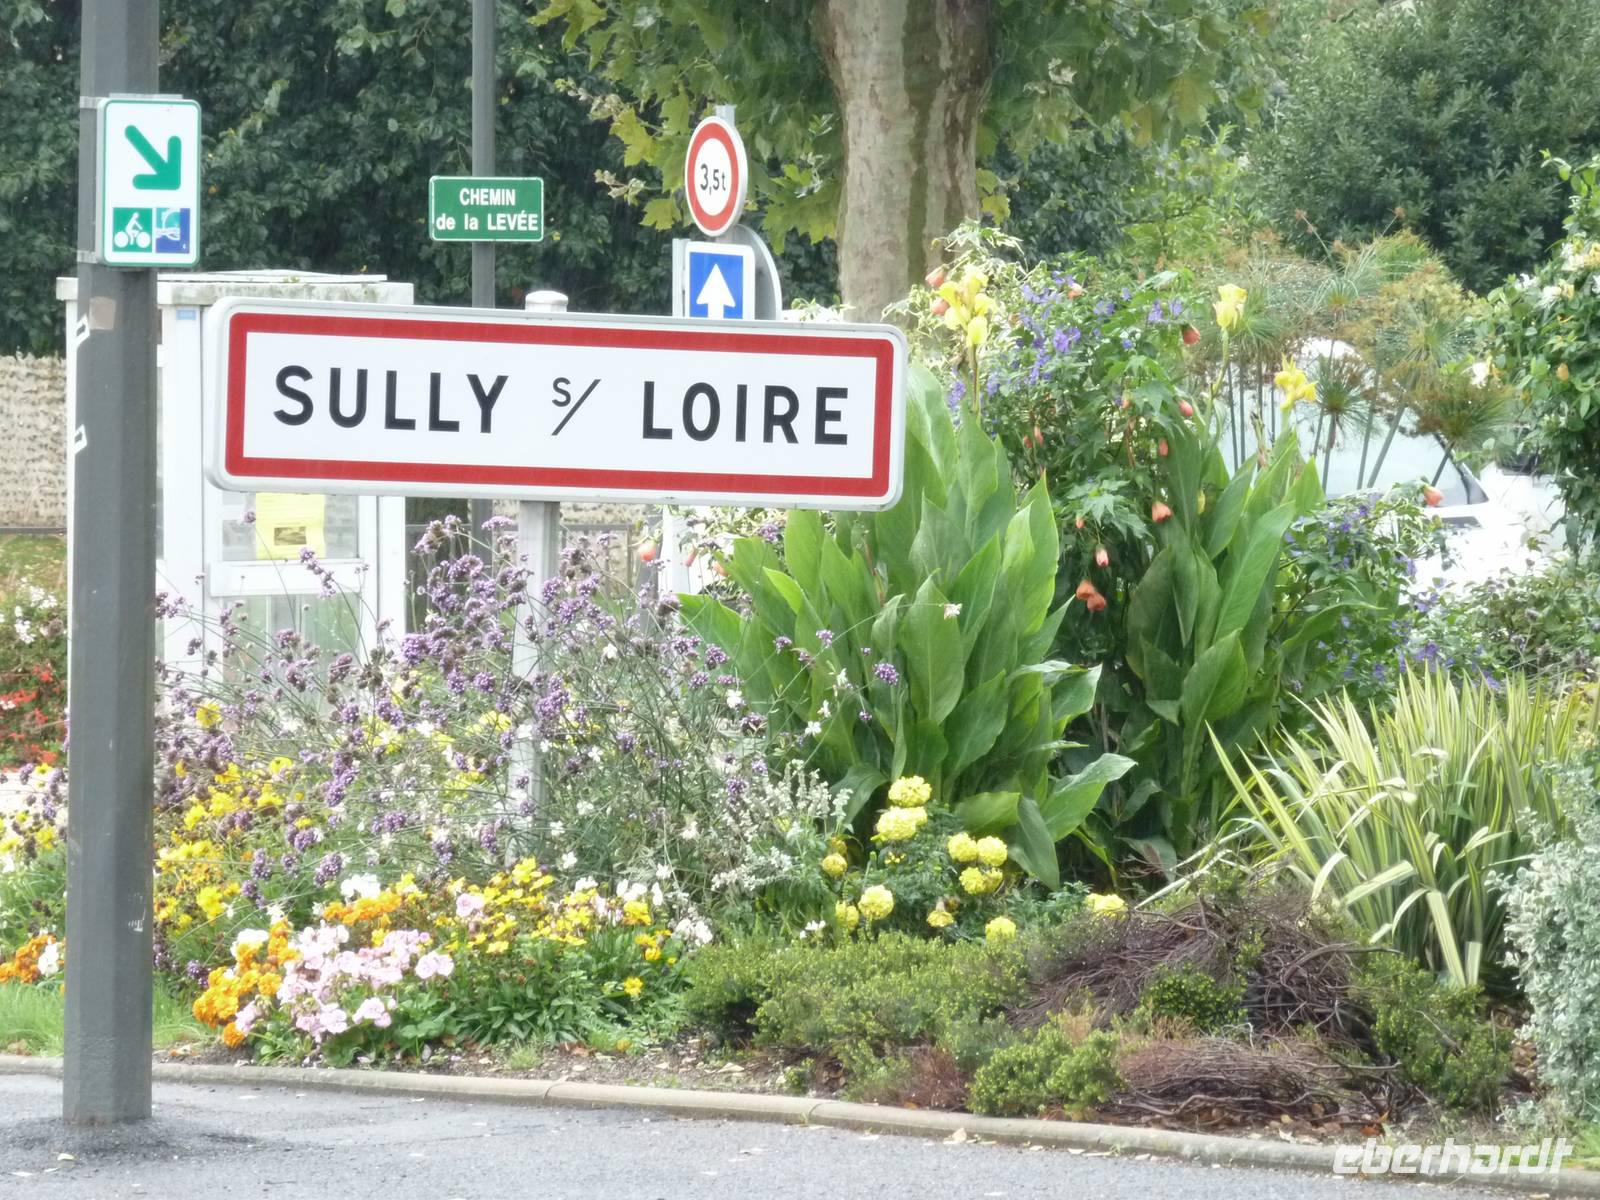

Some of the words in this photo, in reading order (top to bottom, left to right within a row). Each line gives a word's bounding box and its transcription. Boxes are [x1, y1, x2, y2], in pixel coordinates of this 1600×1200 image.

[459, 187, 516, 206] CHEMIN
[436, 213, 456, 230] de
[464, 213, 479, 230] la
[487, 210, 538, 231] LEVÉE
[273, 364, 508, 433] SULLY
[642, 380, 849, 445] LOIRE
